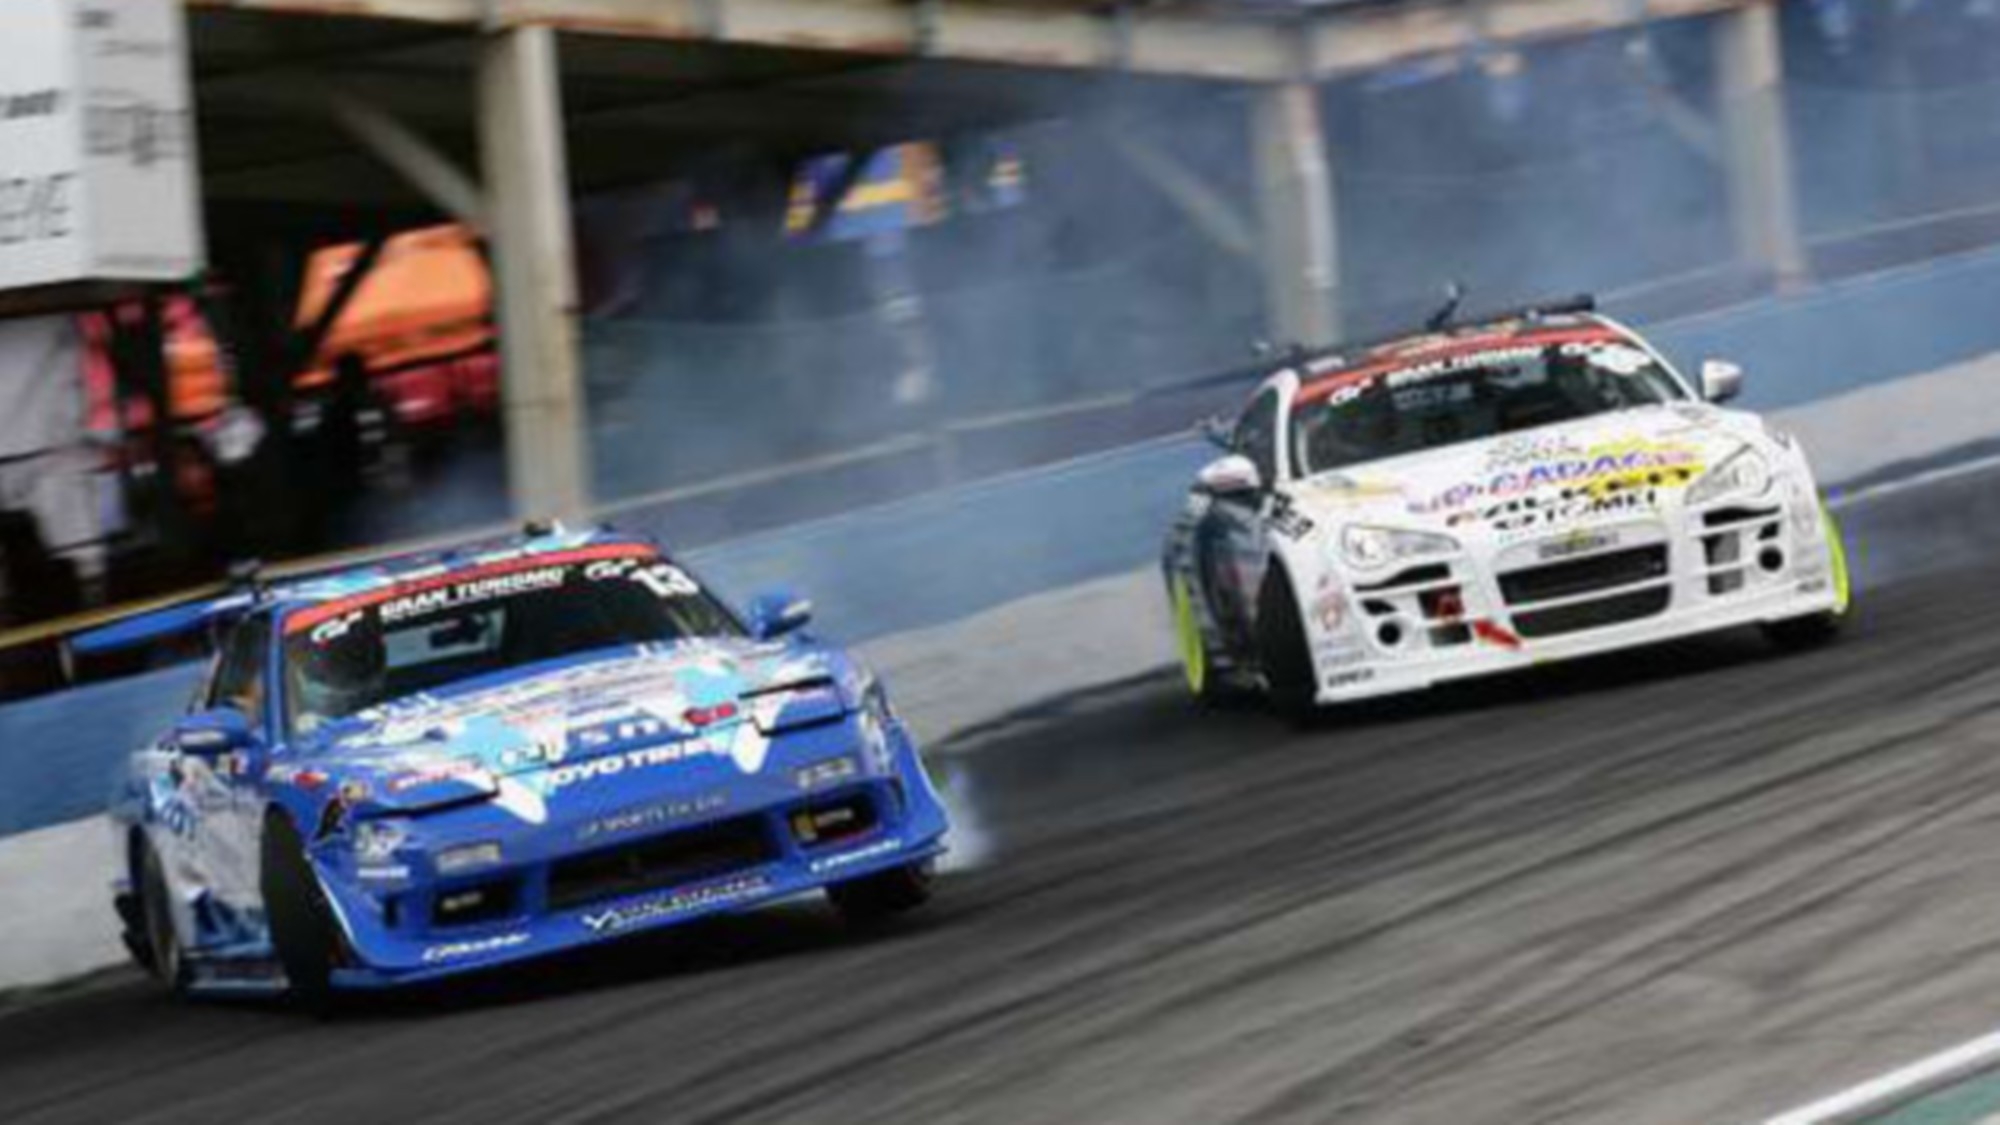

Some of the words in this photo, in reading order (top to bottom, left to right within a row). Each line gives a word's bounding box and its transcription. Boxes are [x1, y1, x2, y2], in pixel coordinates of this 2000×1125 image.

[379, 588, 448, 624] GRAN
[456, 565, 565, 600] TURISMO
[628, 563, 698, 597] 13
